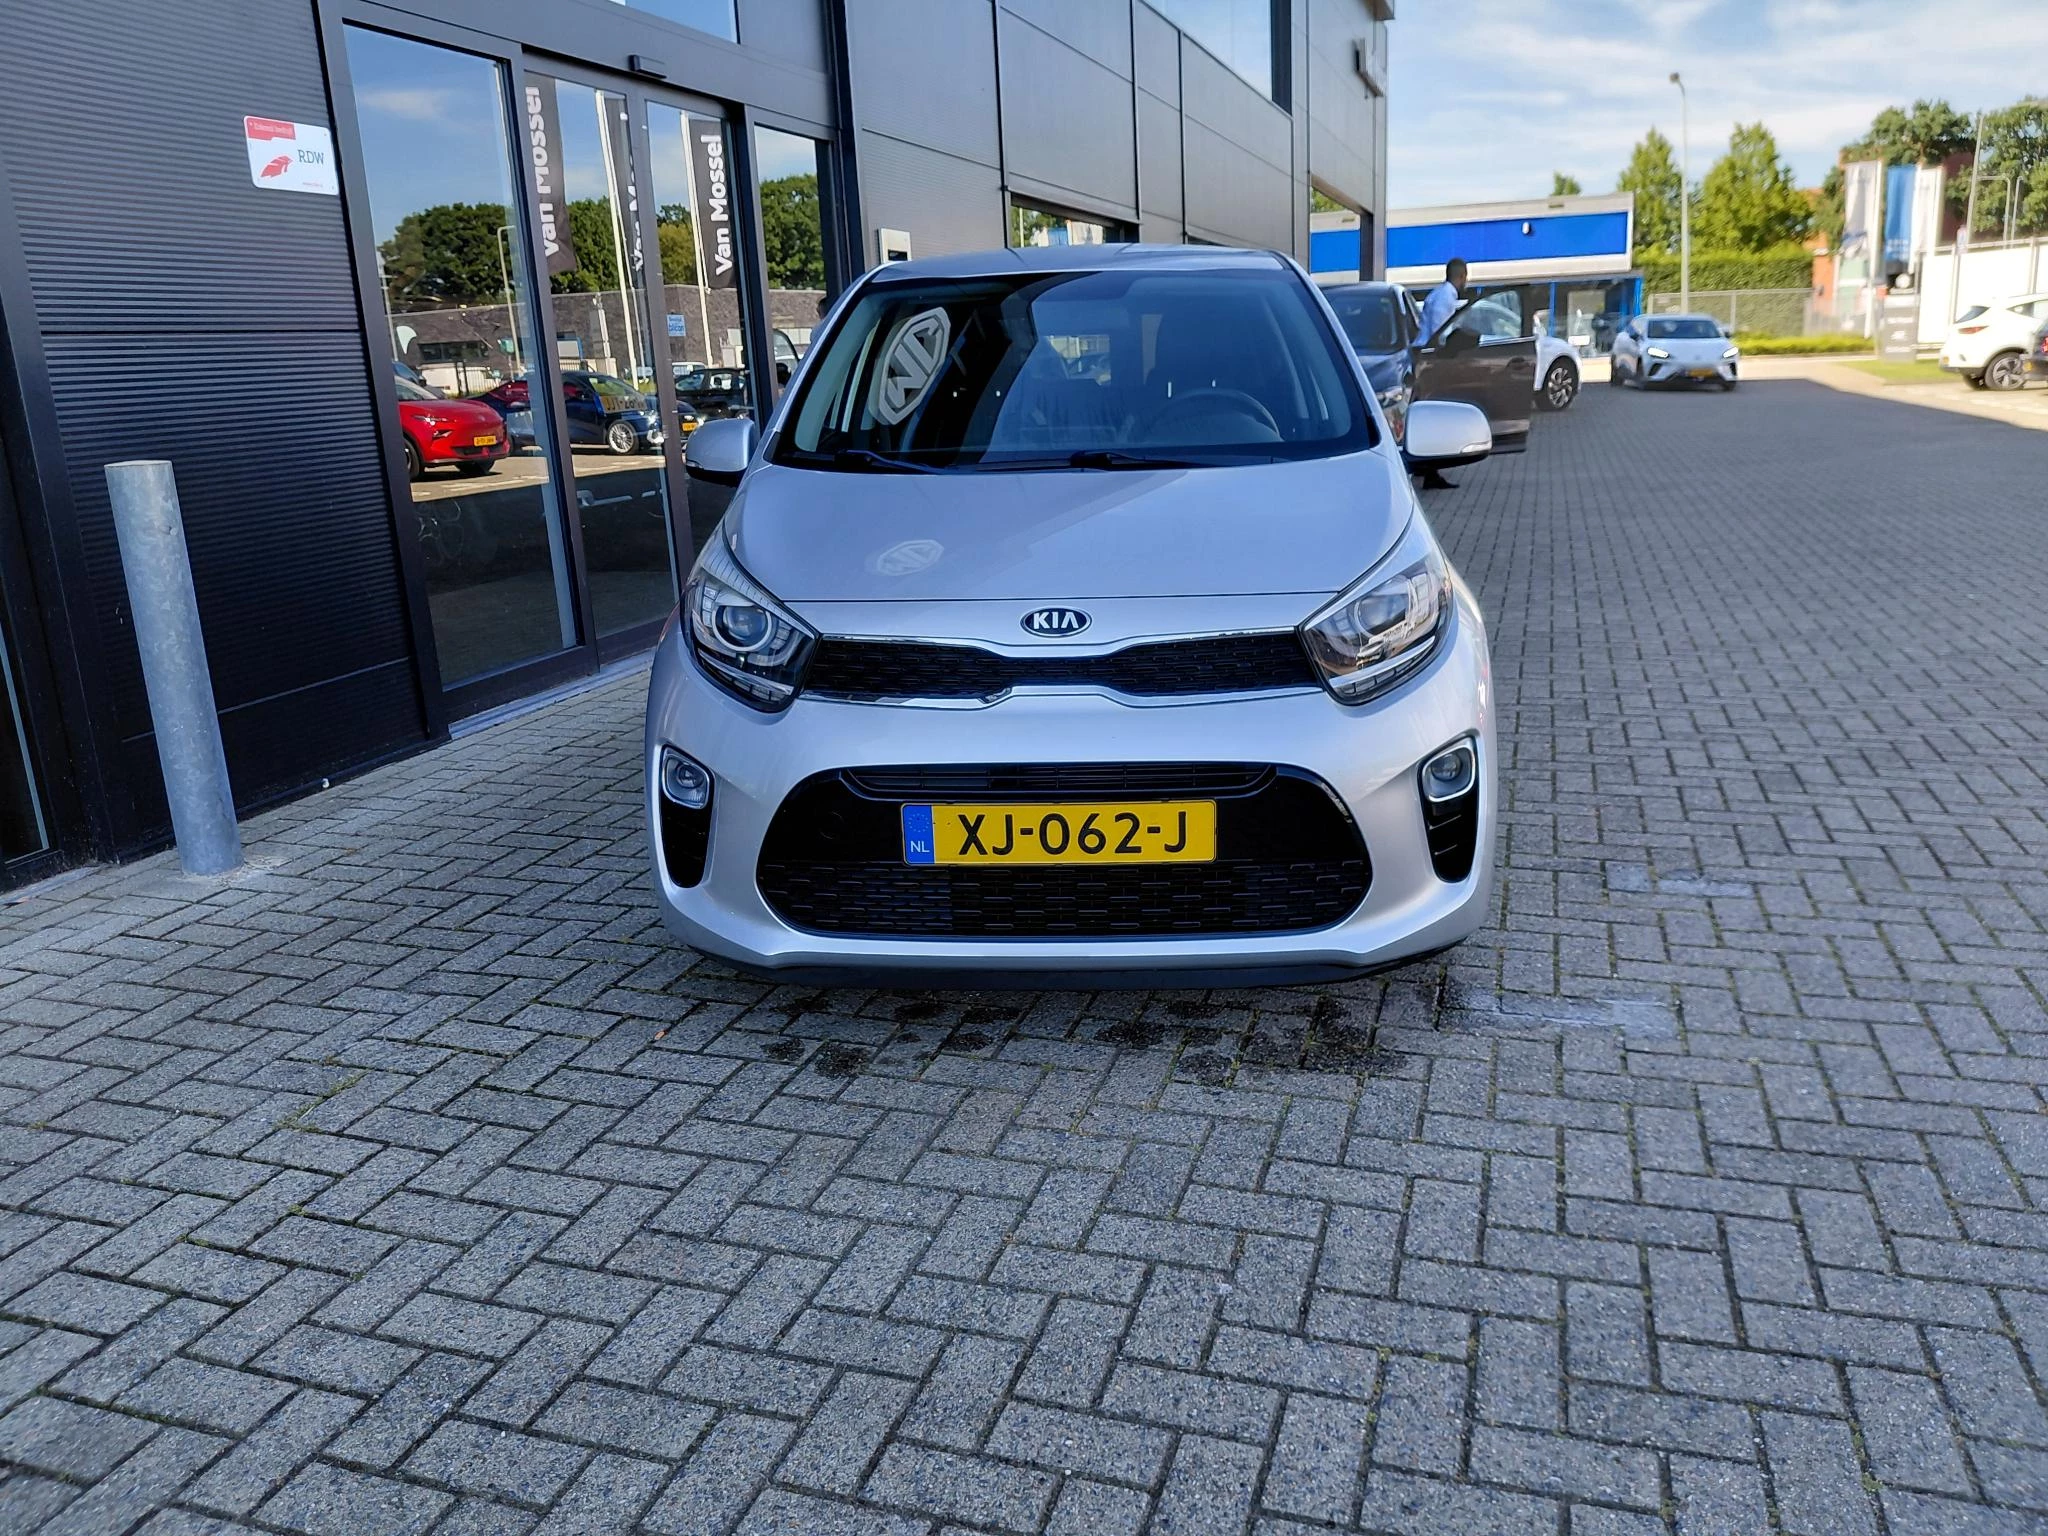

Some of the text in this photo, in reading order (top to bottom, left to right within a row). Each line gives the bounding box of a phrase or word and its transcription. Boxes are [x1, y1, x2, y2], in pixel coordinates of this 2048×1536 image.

[297, 149, 325, 166] RDW
[700, 134, 733, 275] Van Mossel
[1033, 611, 1079, 630] KIA
[957, 810, 1187, 856] XJ-062-J
[910, 840, 930, 853] NL
